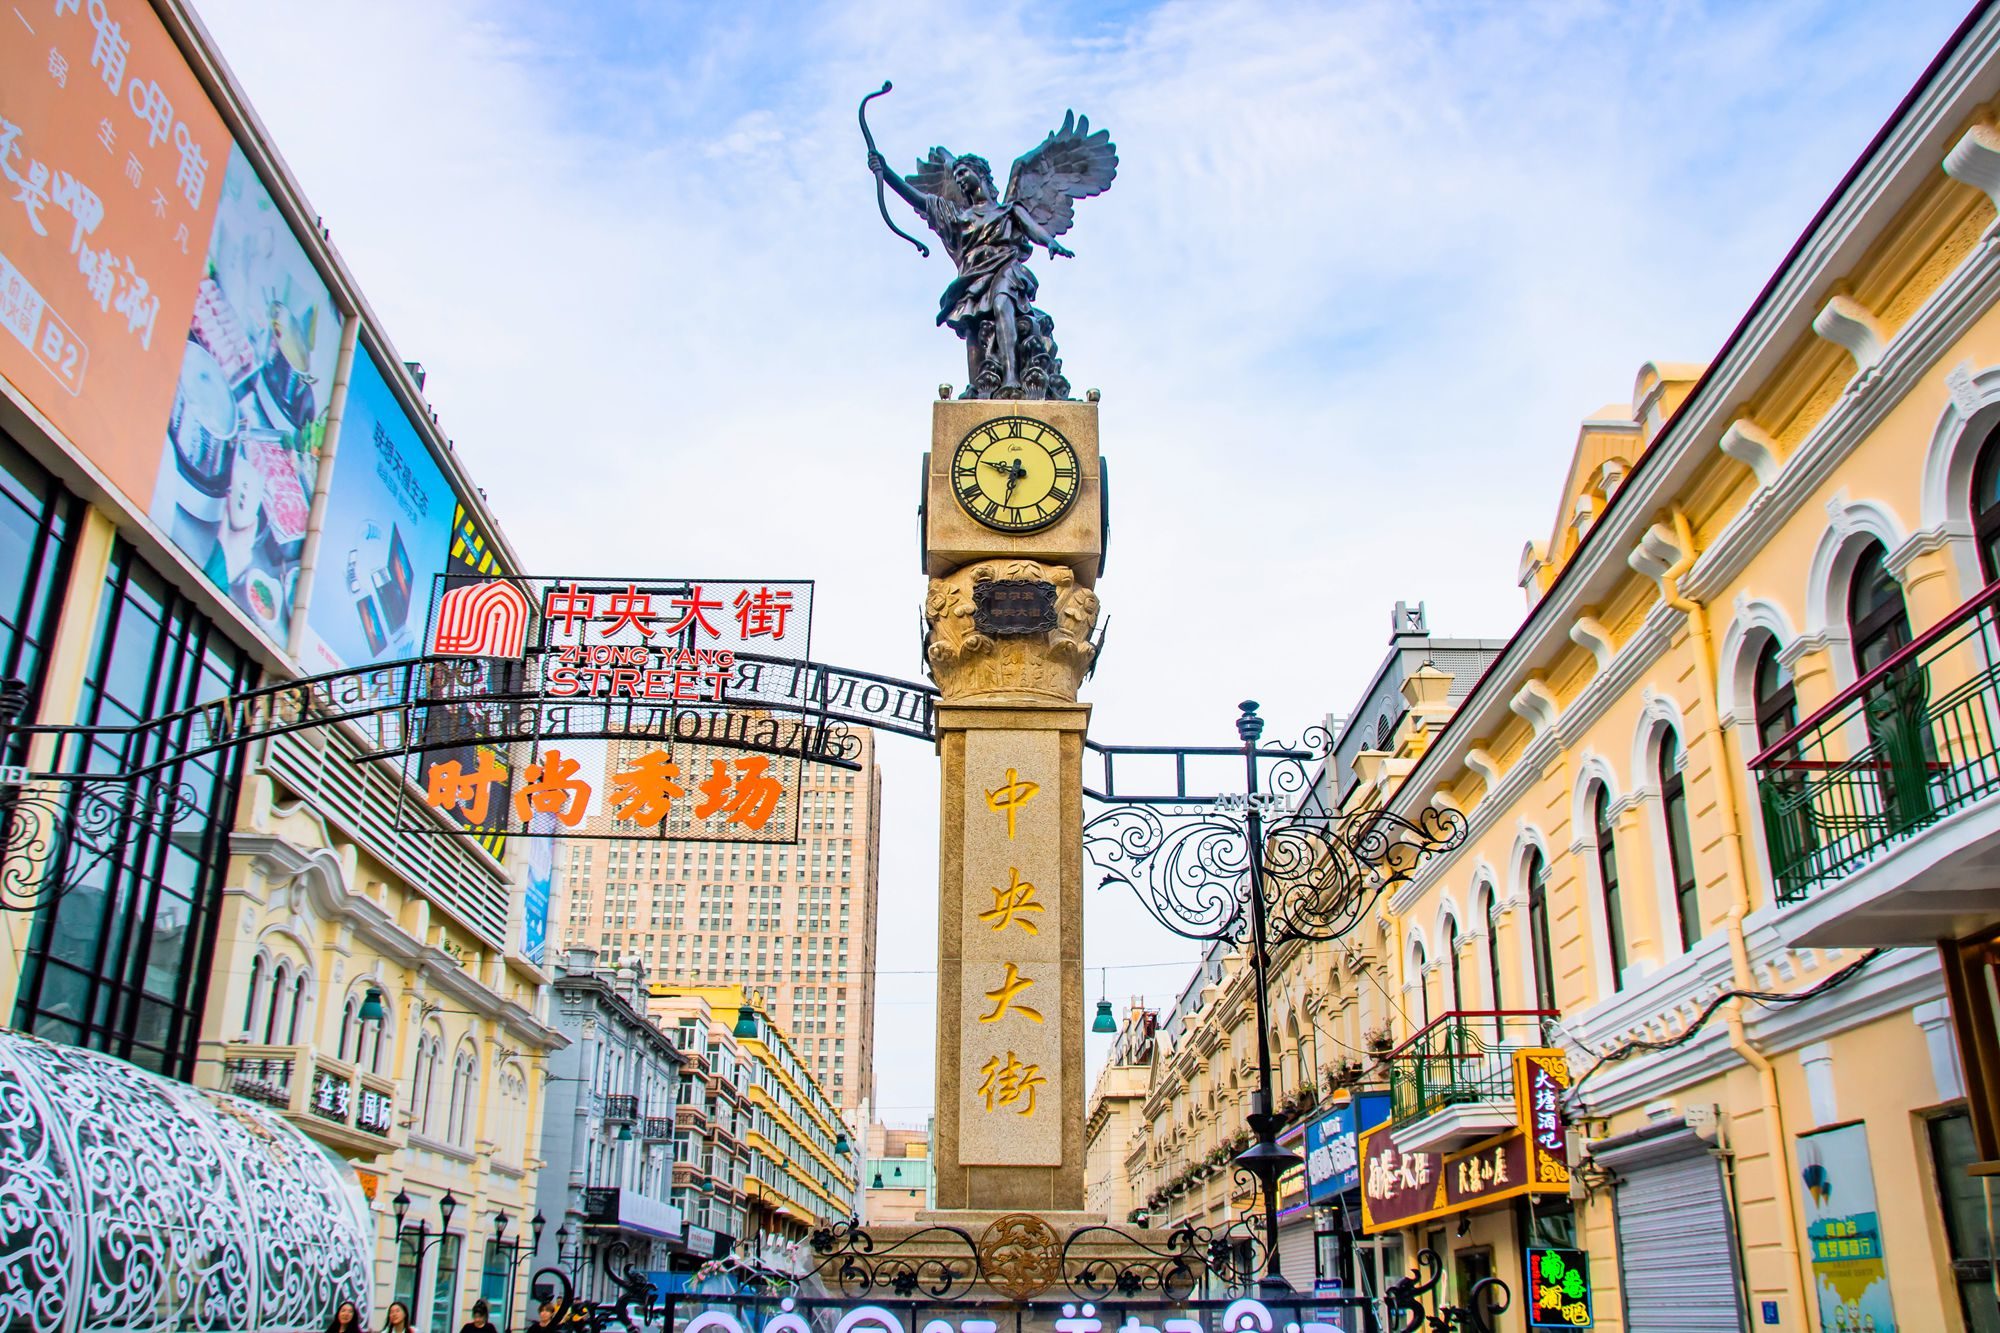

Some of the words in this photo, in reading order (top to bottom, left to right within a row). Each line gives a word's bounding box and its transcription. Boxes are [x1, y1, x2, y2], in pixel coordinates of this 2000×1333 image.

[55, 0, 210, 211] 哺呷哺
[42, 320, 78, 381] B2
[545, 583, 793, 640] 中央大街
[549, 667, 735, 700] STREET
[558, 645, 649, 665] ZHONG
[661, 648, 735, 668] YANG
[427, 749, 784, 831] 时尚秀场
[1213, 792, 1297, 813] AMSTEL
[978, 768, 1048, 1118] 中央大街
[316, 1074, 393, 1131] 金安国际
